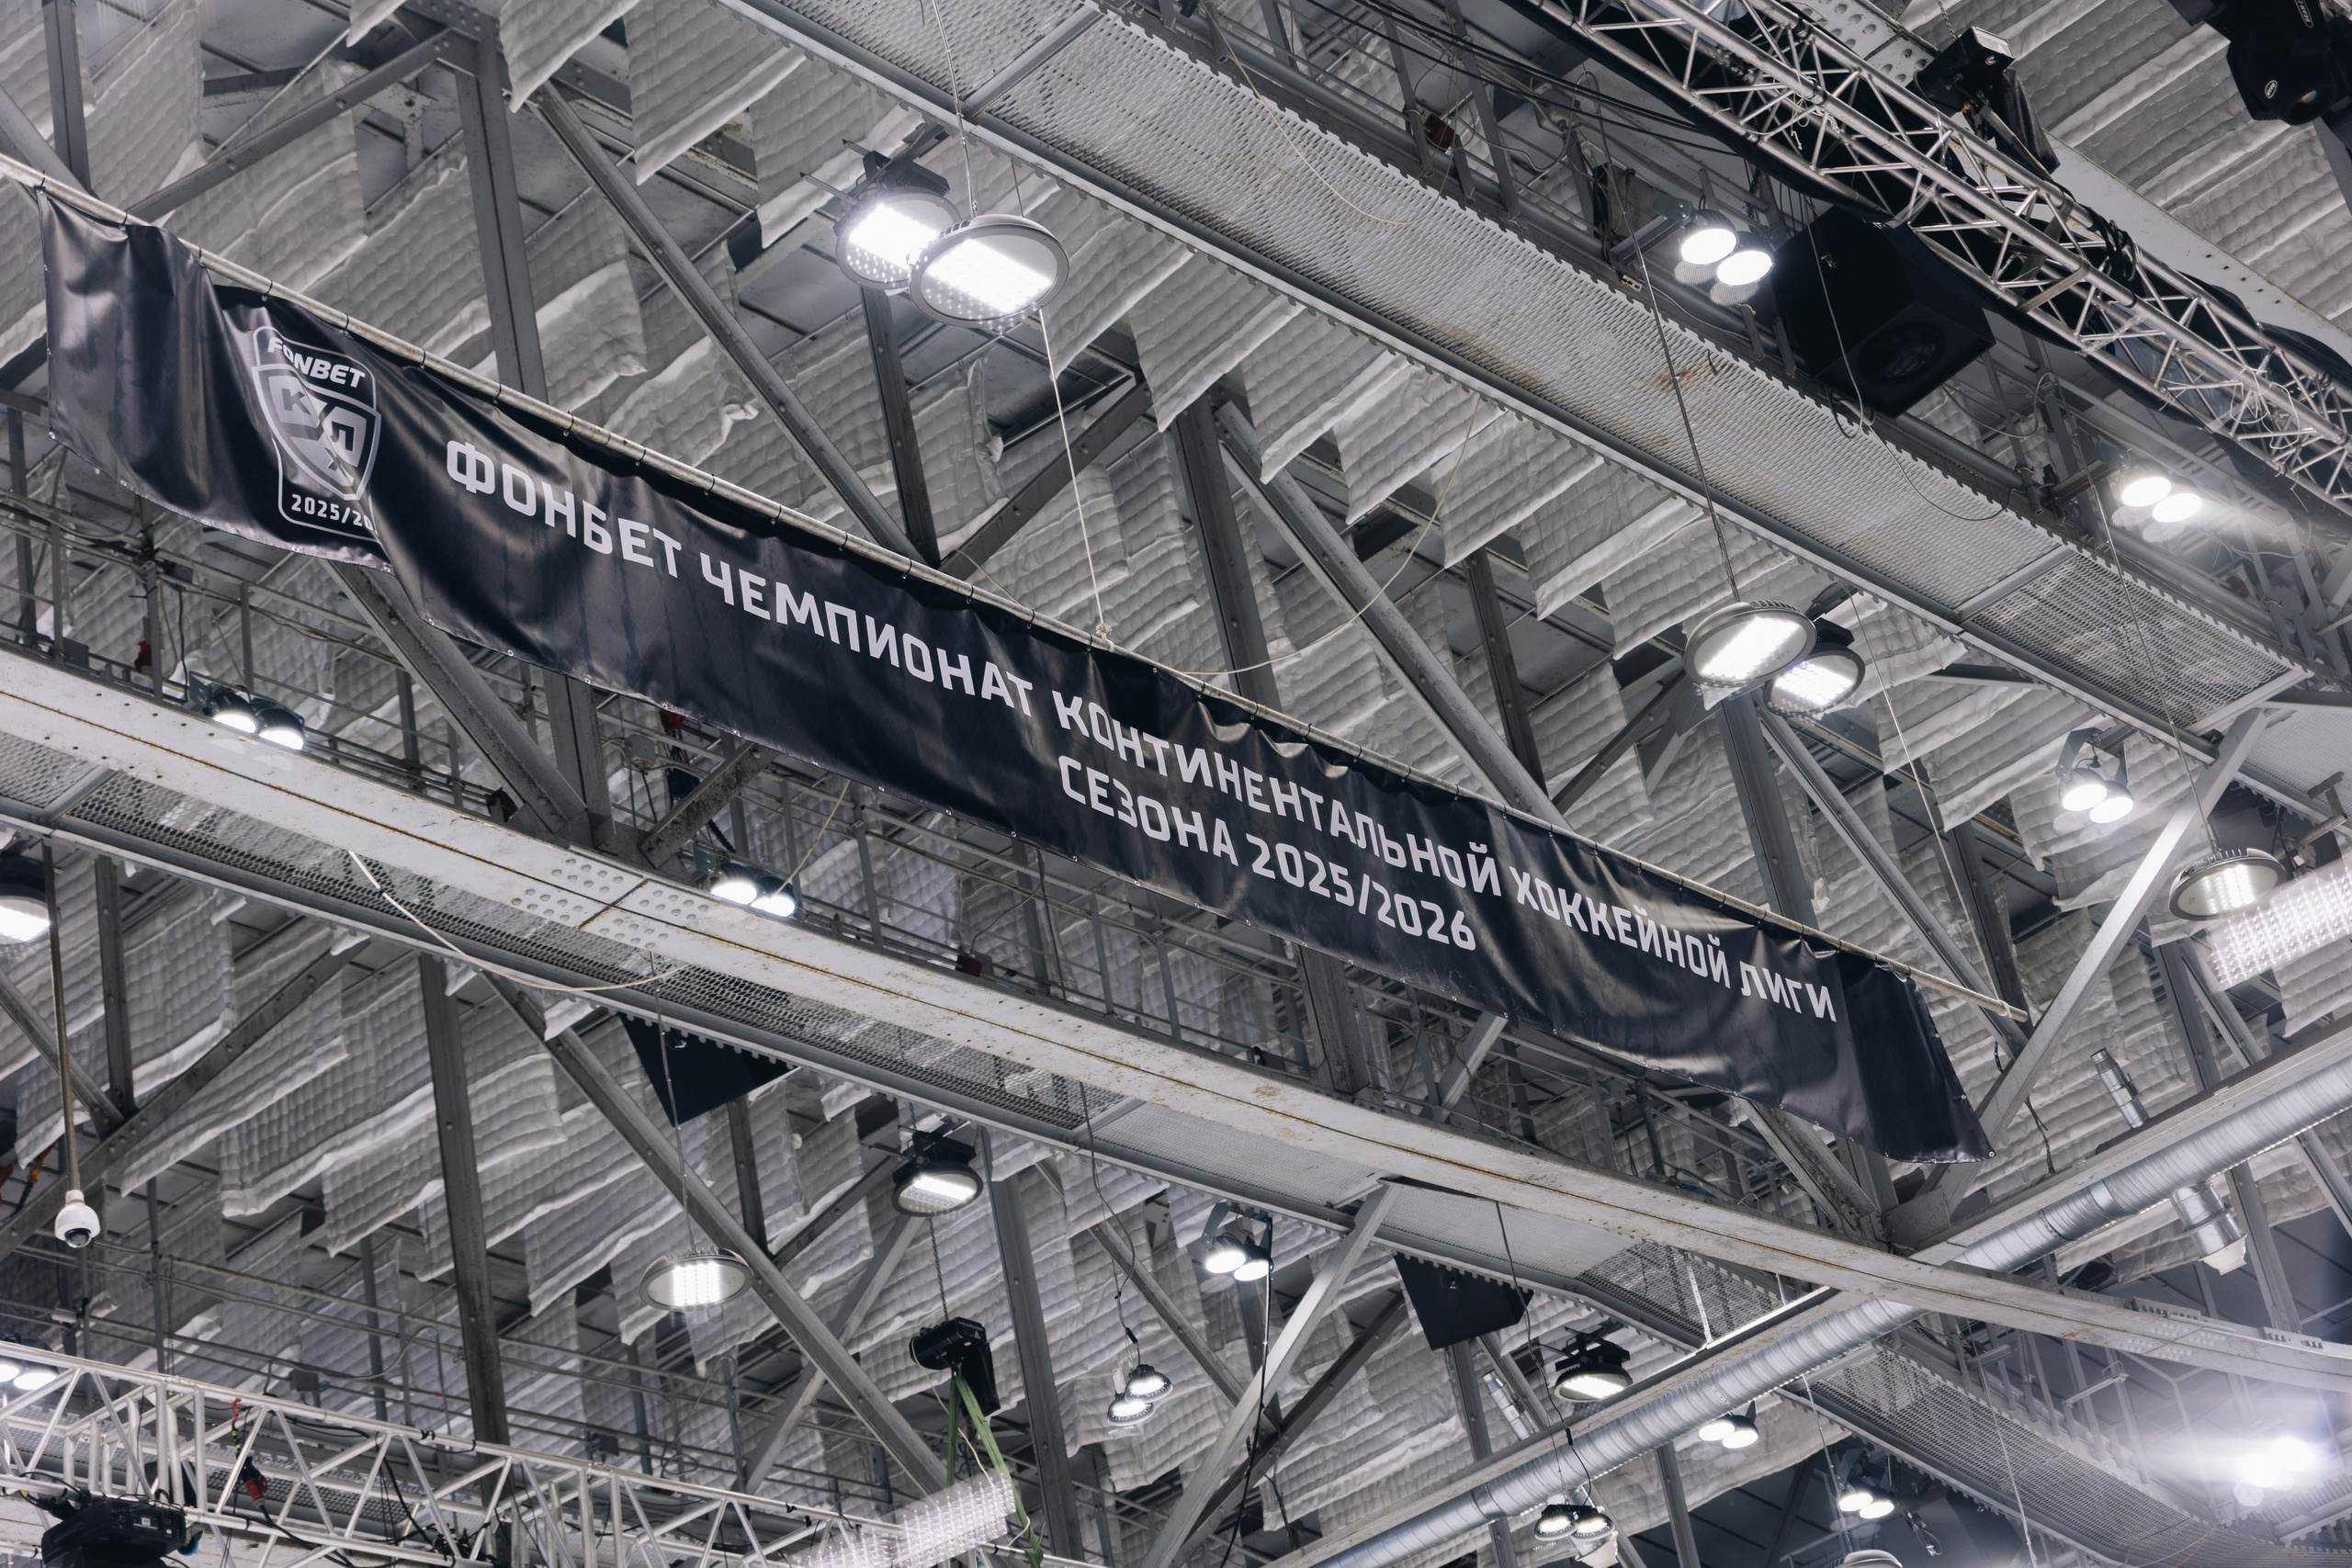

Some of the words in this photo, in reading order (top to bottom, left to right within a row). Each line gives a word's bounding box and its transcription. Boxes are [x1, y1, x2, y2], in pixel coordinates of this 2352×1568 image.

[267, 337, 366, 388] FONBET
[291, 493, 374, 532] 2025/20
[447, 440, 683, 578] ФОНБЕТ
[700, 552, 1033, 717] ЧЕМПИОНАТ
[1052, 690, 1502, 897] КОНТИНЕНТАЛЬНОЙ
[1510, 865, 1731, 989] ХОККЕЙНОЙ
[1740, 960, 1838, 1023] ЛИГИ
[1057, 755, 1239, 867] СЕЗОНА
[1246, 832, 1476, 951] 2025/2026
